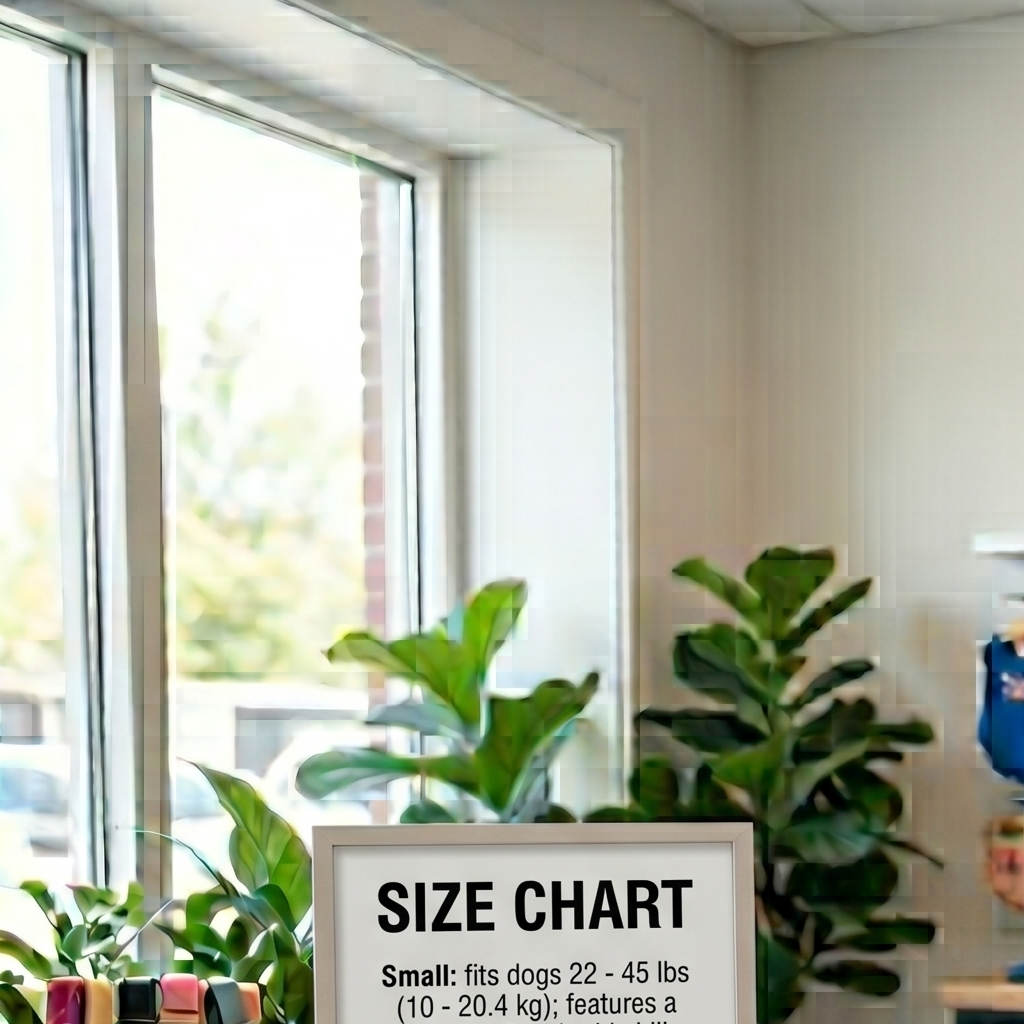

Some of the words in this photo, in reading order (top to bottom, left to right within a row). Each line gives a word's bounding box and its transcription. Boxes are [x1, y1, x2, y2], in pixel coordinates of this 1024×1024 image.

[377, 881, 495, 933] SIZE
[514, 878, 693, 931] CHART
[381, 963, 456, 987] Small:
[463, 963, 499, 986] fits
[506, 962, 561, 990] dogs
[569, 961, 596, 984] 22
[621, 960, 648, 983] 45
[657, 960, 689, 983] lbs
[397, 995, 433, 1024] (10
[458, 993, 508, 1017] 20.4
[516, 992, 557, 1021] kg);
[565, 992, 656, 1015] features
[664, 995, 677, 1013] a
